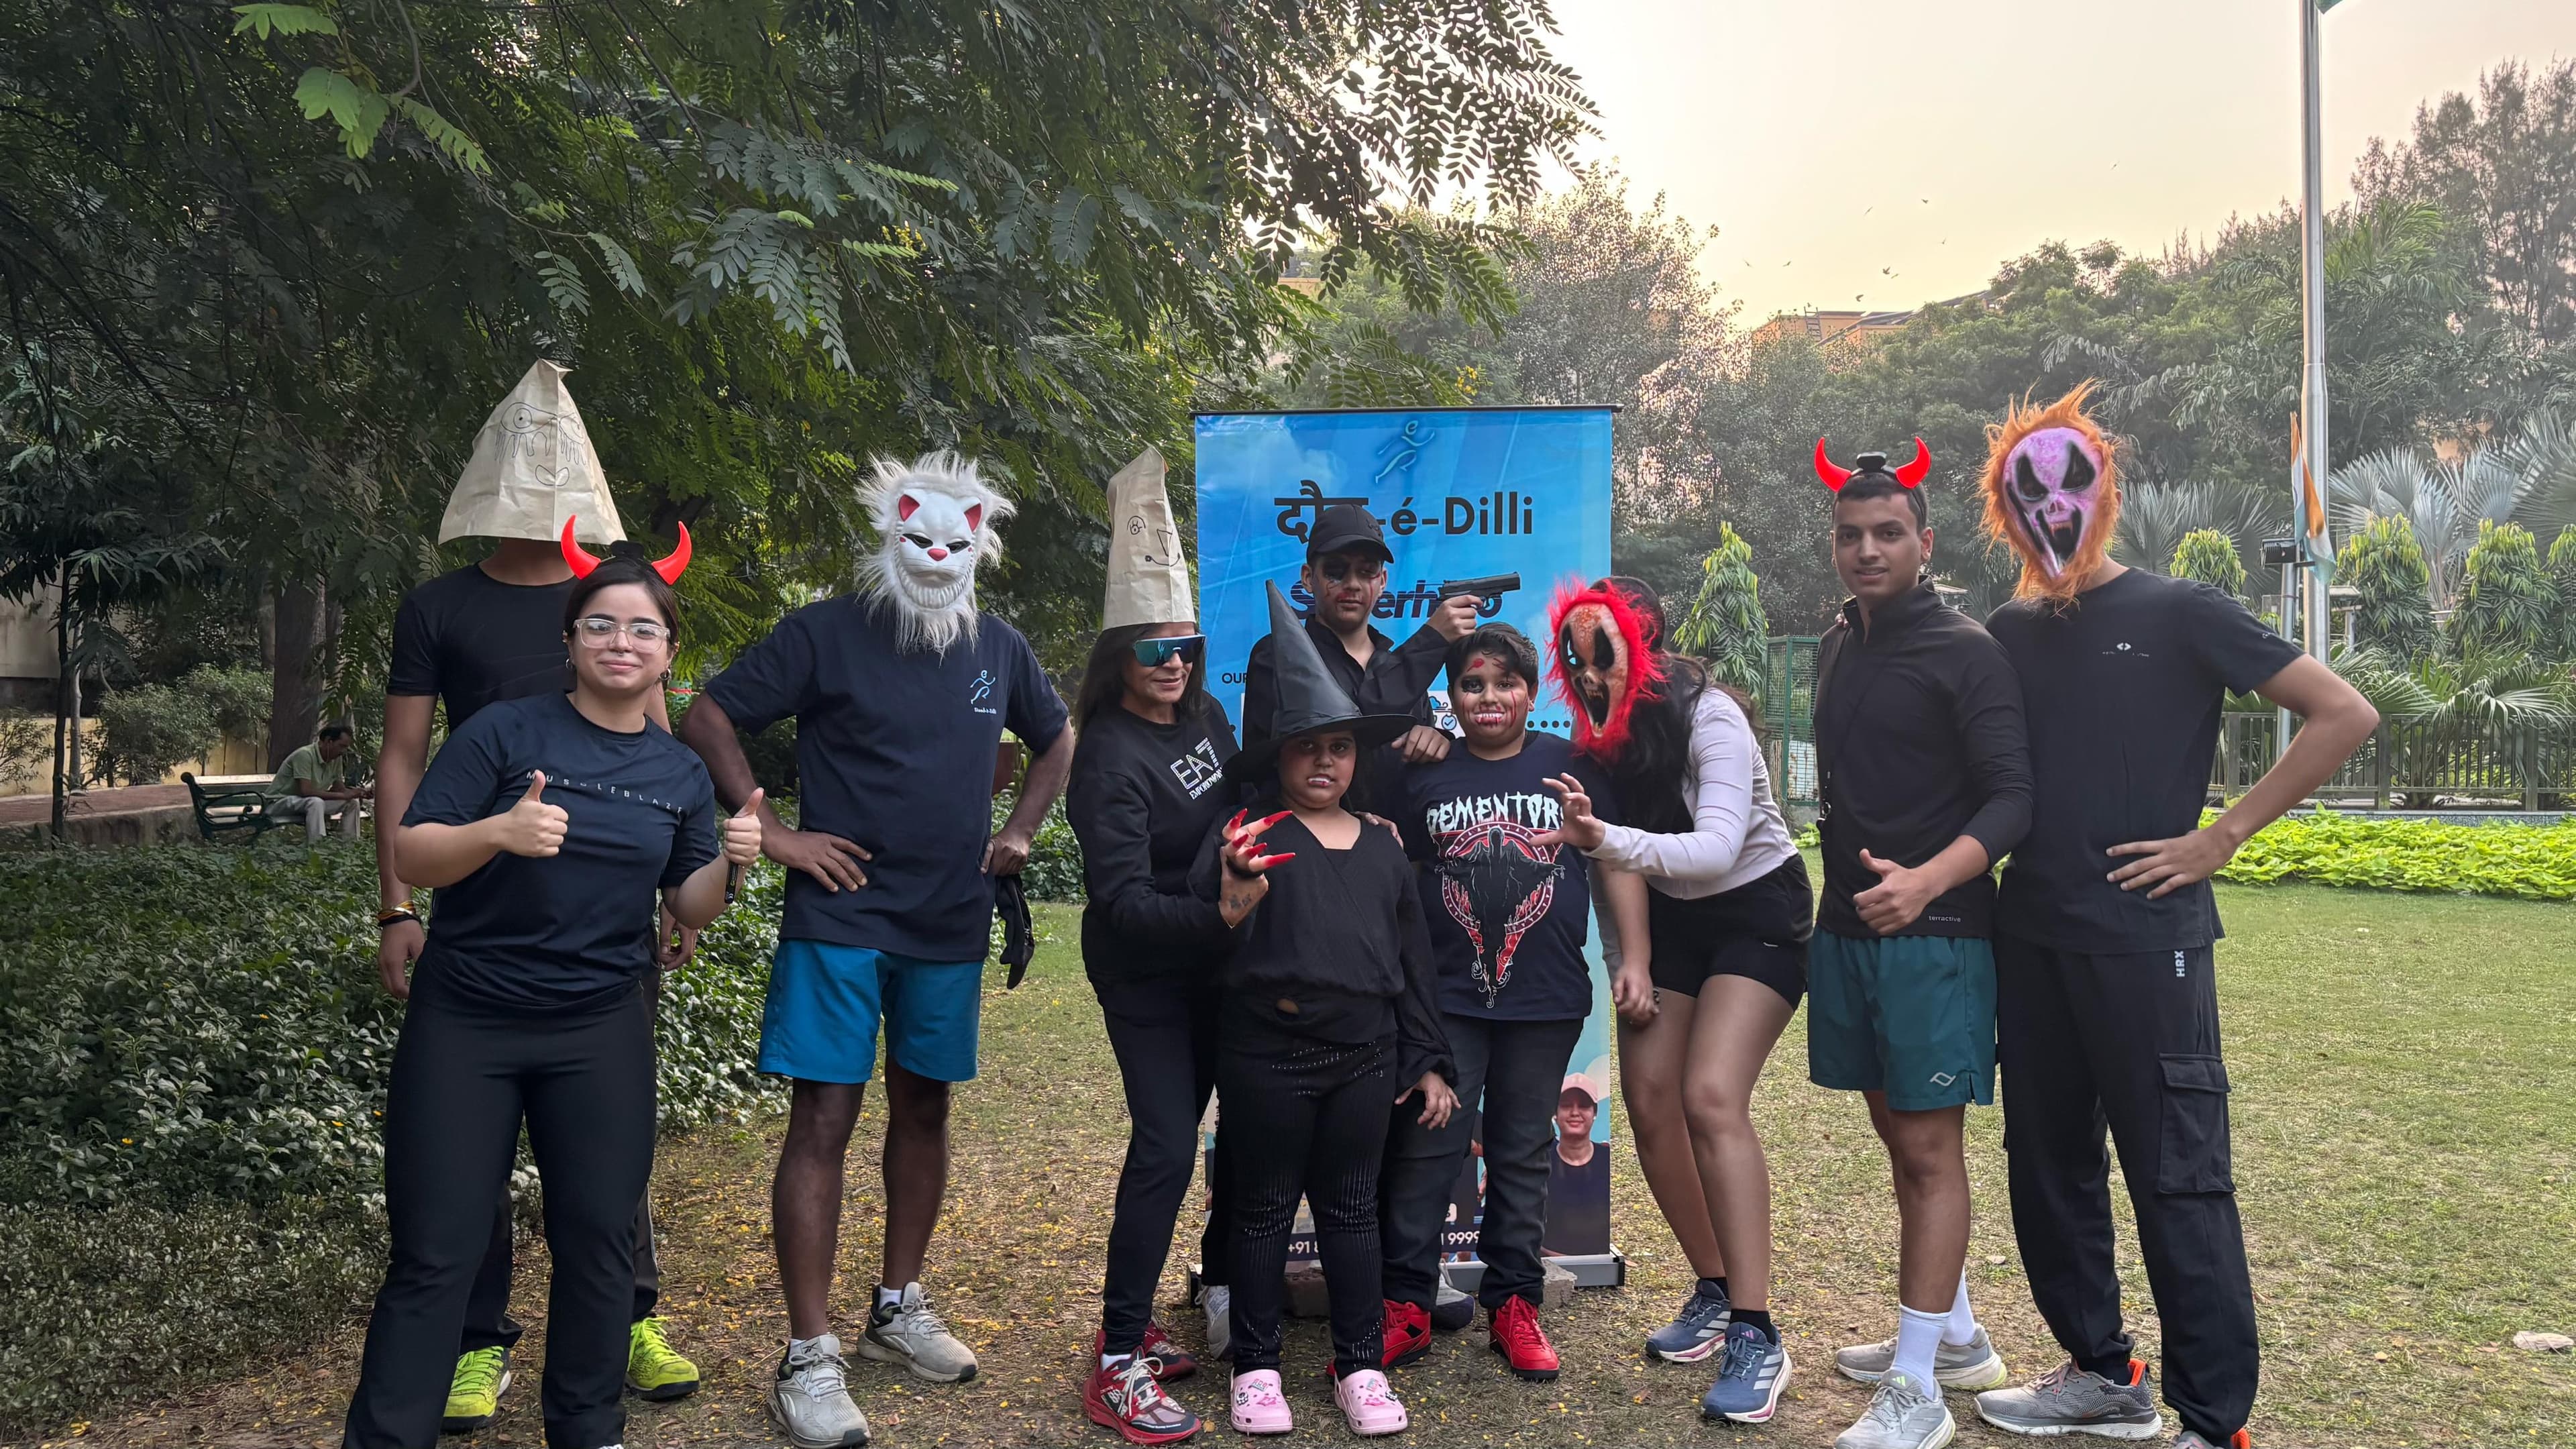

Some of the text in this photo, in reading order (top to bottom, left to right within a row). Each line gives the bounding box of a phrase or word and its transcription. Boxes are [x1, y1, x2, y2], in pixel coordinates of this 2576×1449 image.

[1170, 737, 1220, 790] EA7
[2174, 951, 2185, 977] HRX
[1288, 1240, 1310, 1254] +91
